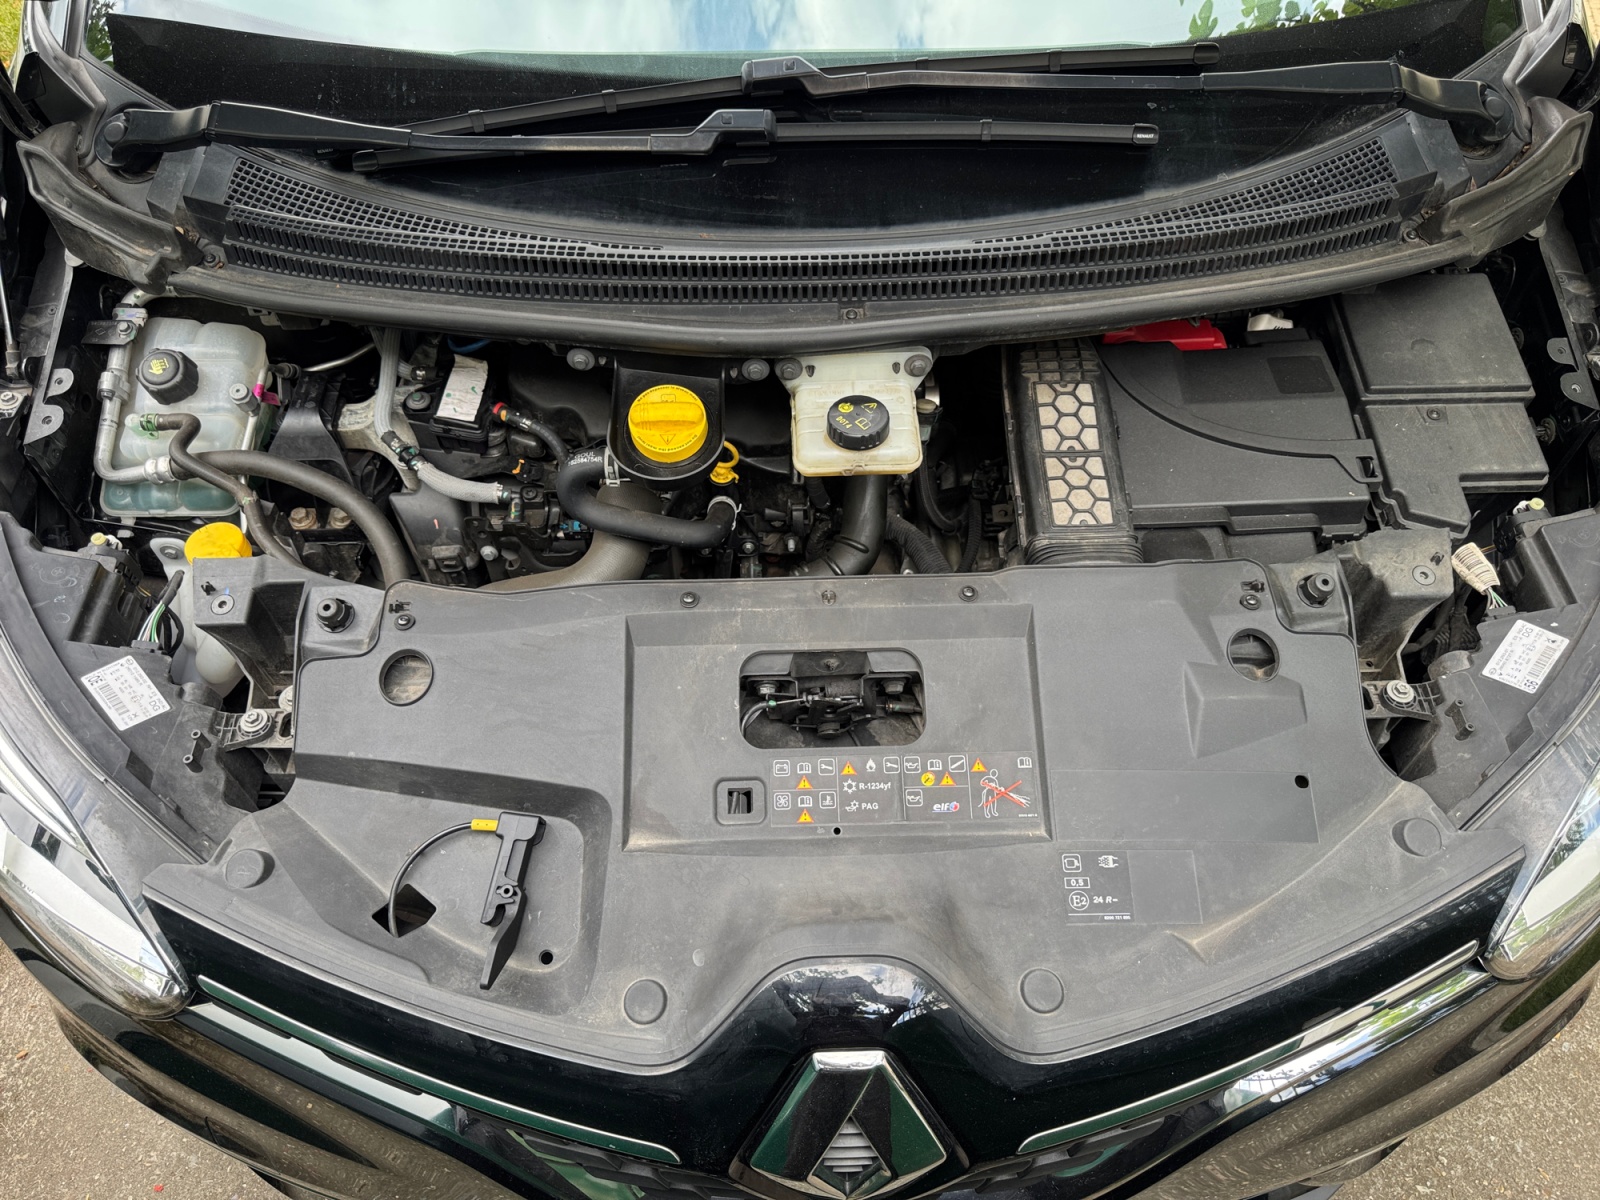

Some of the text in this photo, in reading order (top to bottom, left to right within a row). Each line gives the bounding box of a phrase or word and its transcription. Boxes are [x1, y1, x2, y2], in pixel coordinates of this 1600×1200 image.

[1522, 627, 1534, 638] DG
[1524, 679, 1538, 690] 56
[148, 700, 160, 712] DG
[858, 782, 892, 790] R-1234yf
[932, 802, 950, 811] elf
[1070, 879, 1084, 887] 0,5
[1072, 895, 1087, 907] E2
